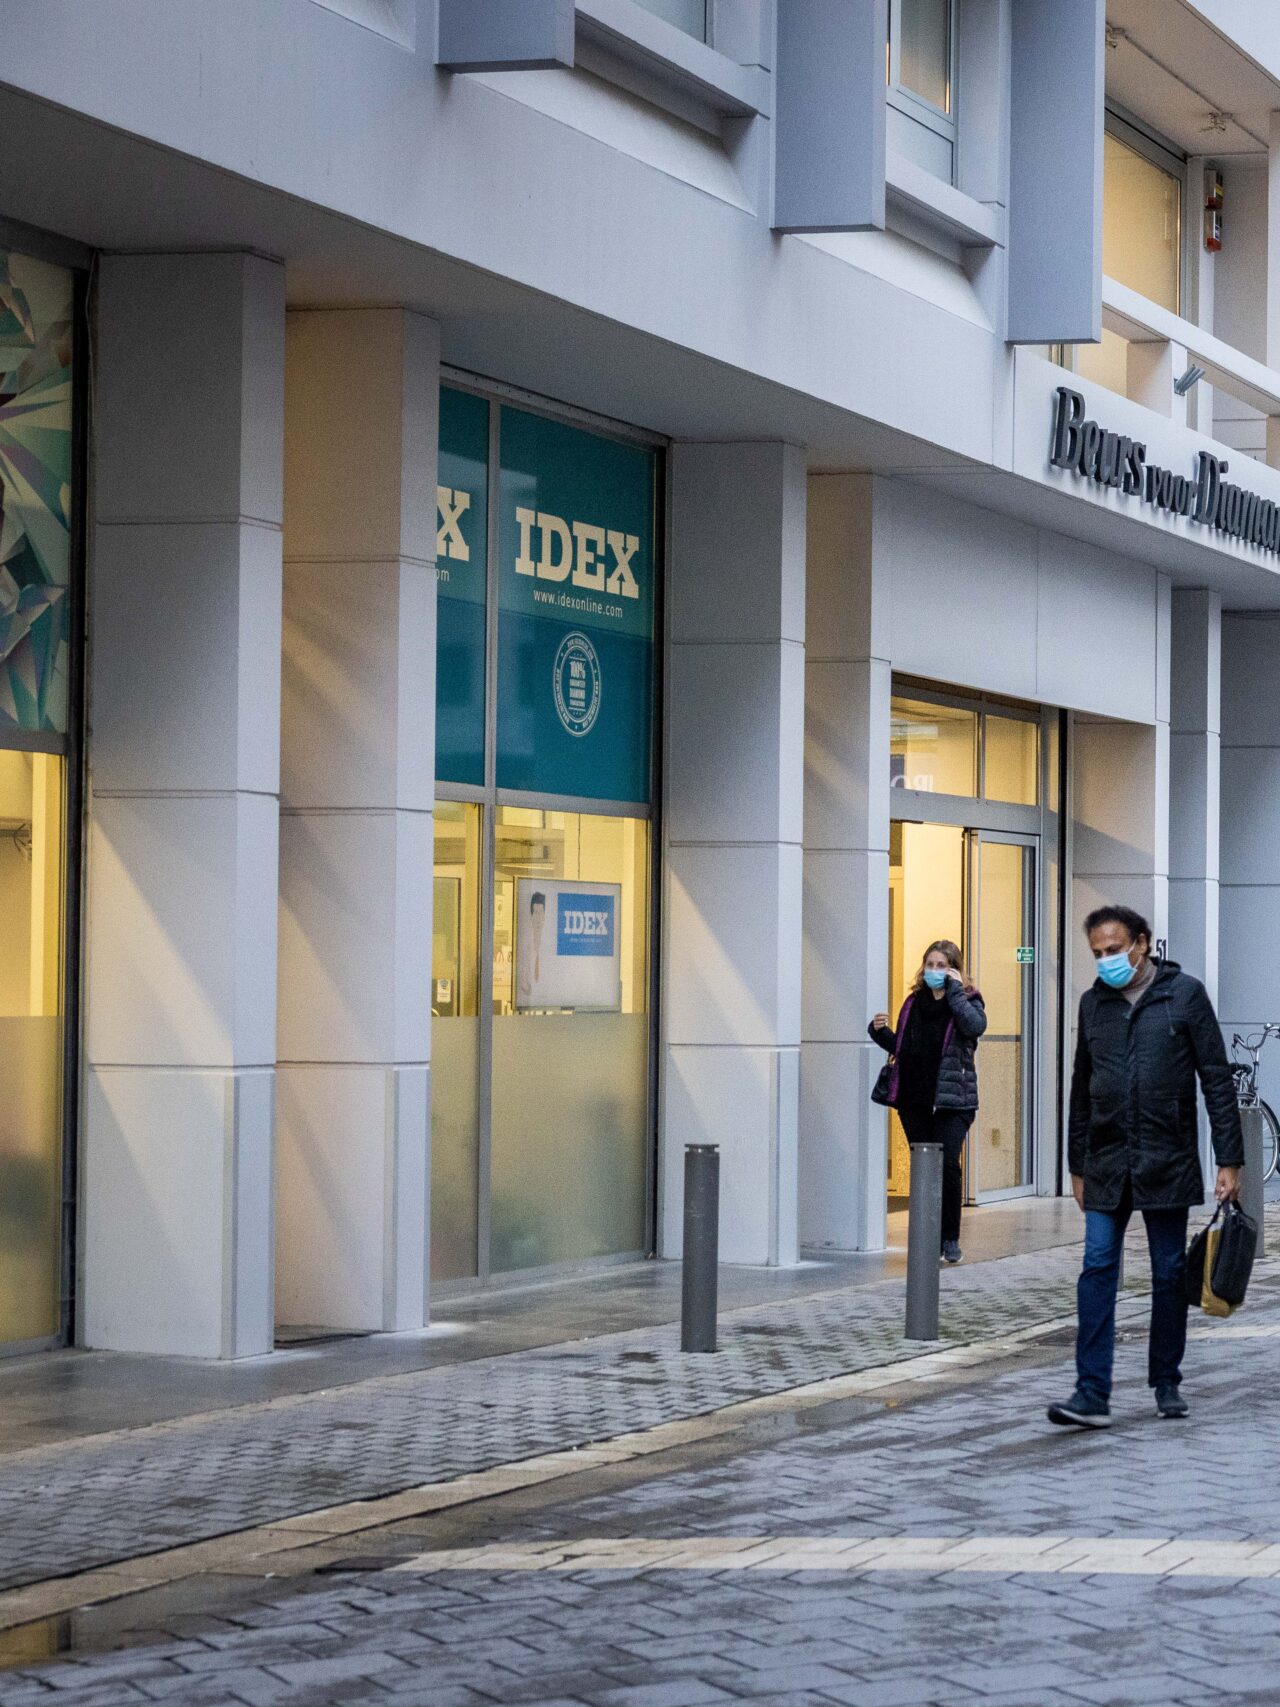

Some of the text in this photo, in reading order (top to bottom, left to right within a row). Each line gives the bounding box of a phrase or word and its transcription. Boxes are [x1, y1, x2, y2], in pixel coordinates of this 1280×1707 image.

[1050, 386, 1146, 496] Beurs
[1146, 465, 1197, 515] voor
[515, 506, 639, 599] IDEX
[533, 589, 622, 618] www.idexonline.com
[564, 910, 608, 936] IDEX
[1156, 938, 1167, 961] 51
